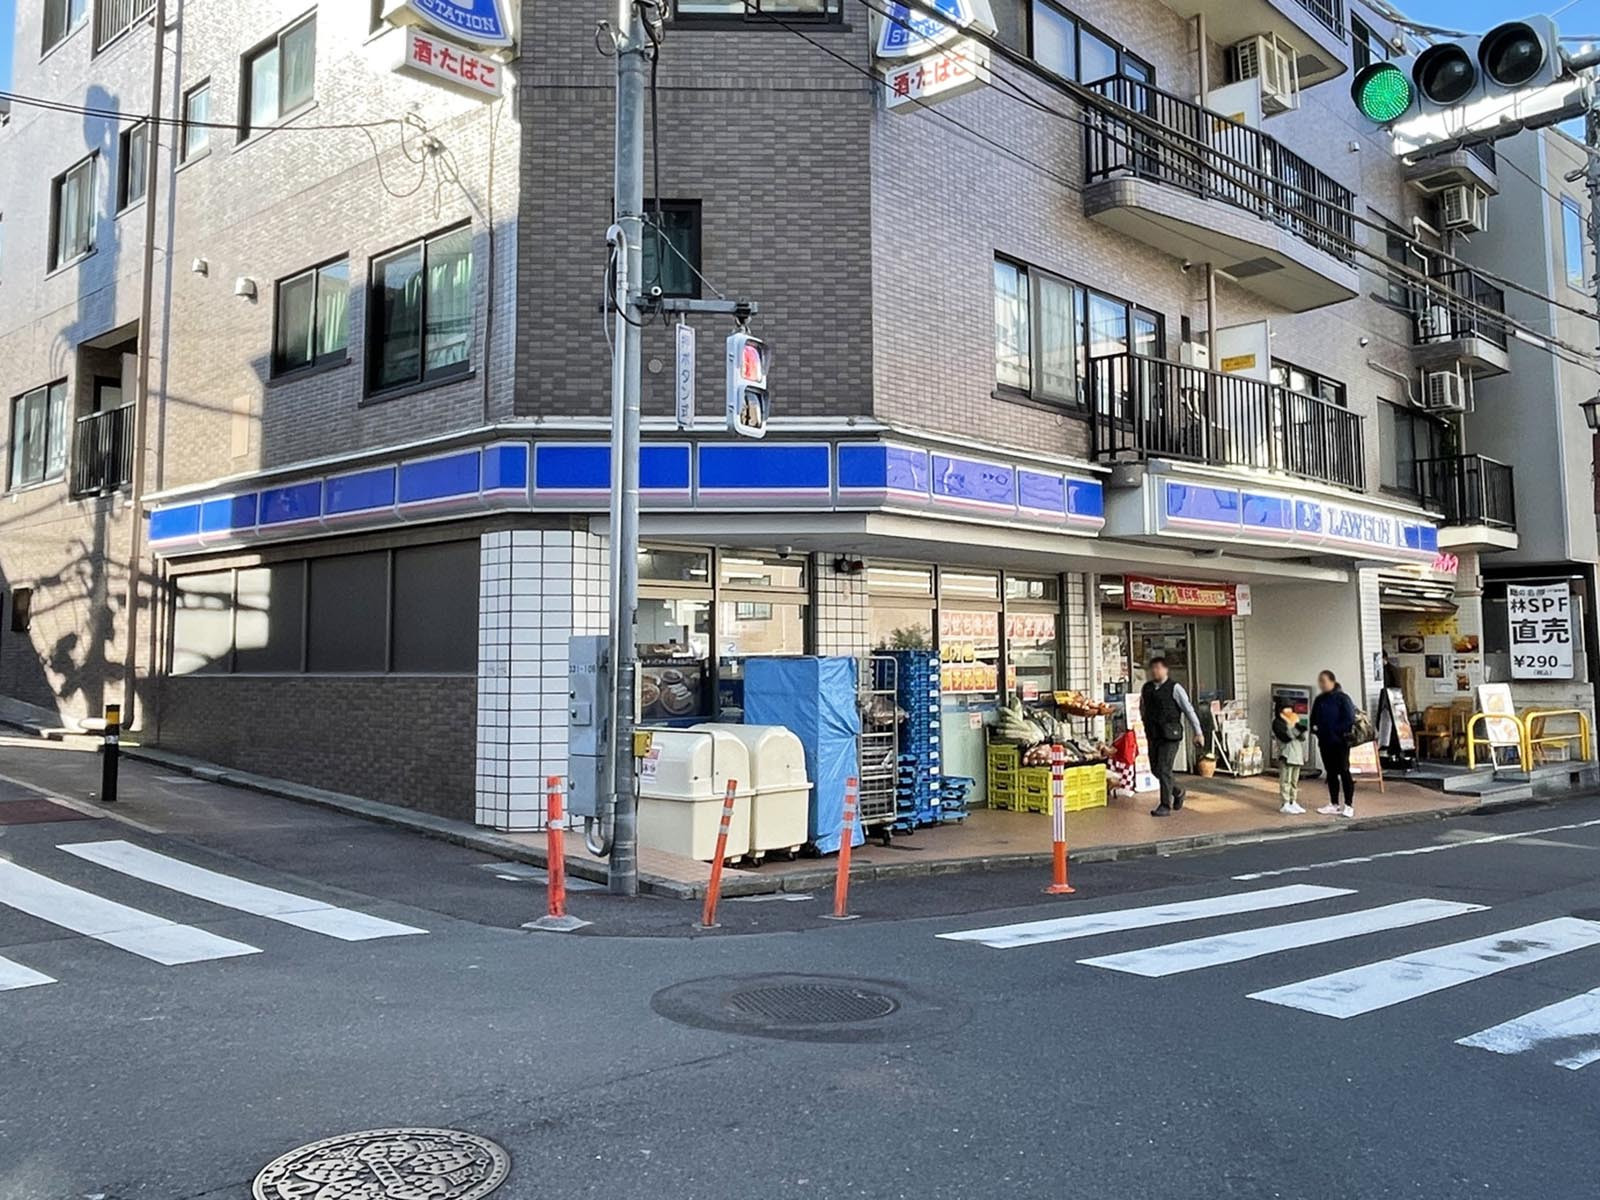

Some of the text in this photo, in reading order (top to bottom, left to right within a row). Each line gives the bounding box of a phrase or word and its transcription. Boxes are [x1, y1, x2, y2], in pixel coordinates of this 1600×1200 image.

[423, 0, 496, 32] STATION
[413, 36, 496, 88] 酒・たばこ
[893, 53, 967, 98] 酒・たばこ
[1327, 506, 1391, 545] LAWSON
[1511, 618, 1570, 645] 直売
[1513, 655, 1558, 668] ¥290
